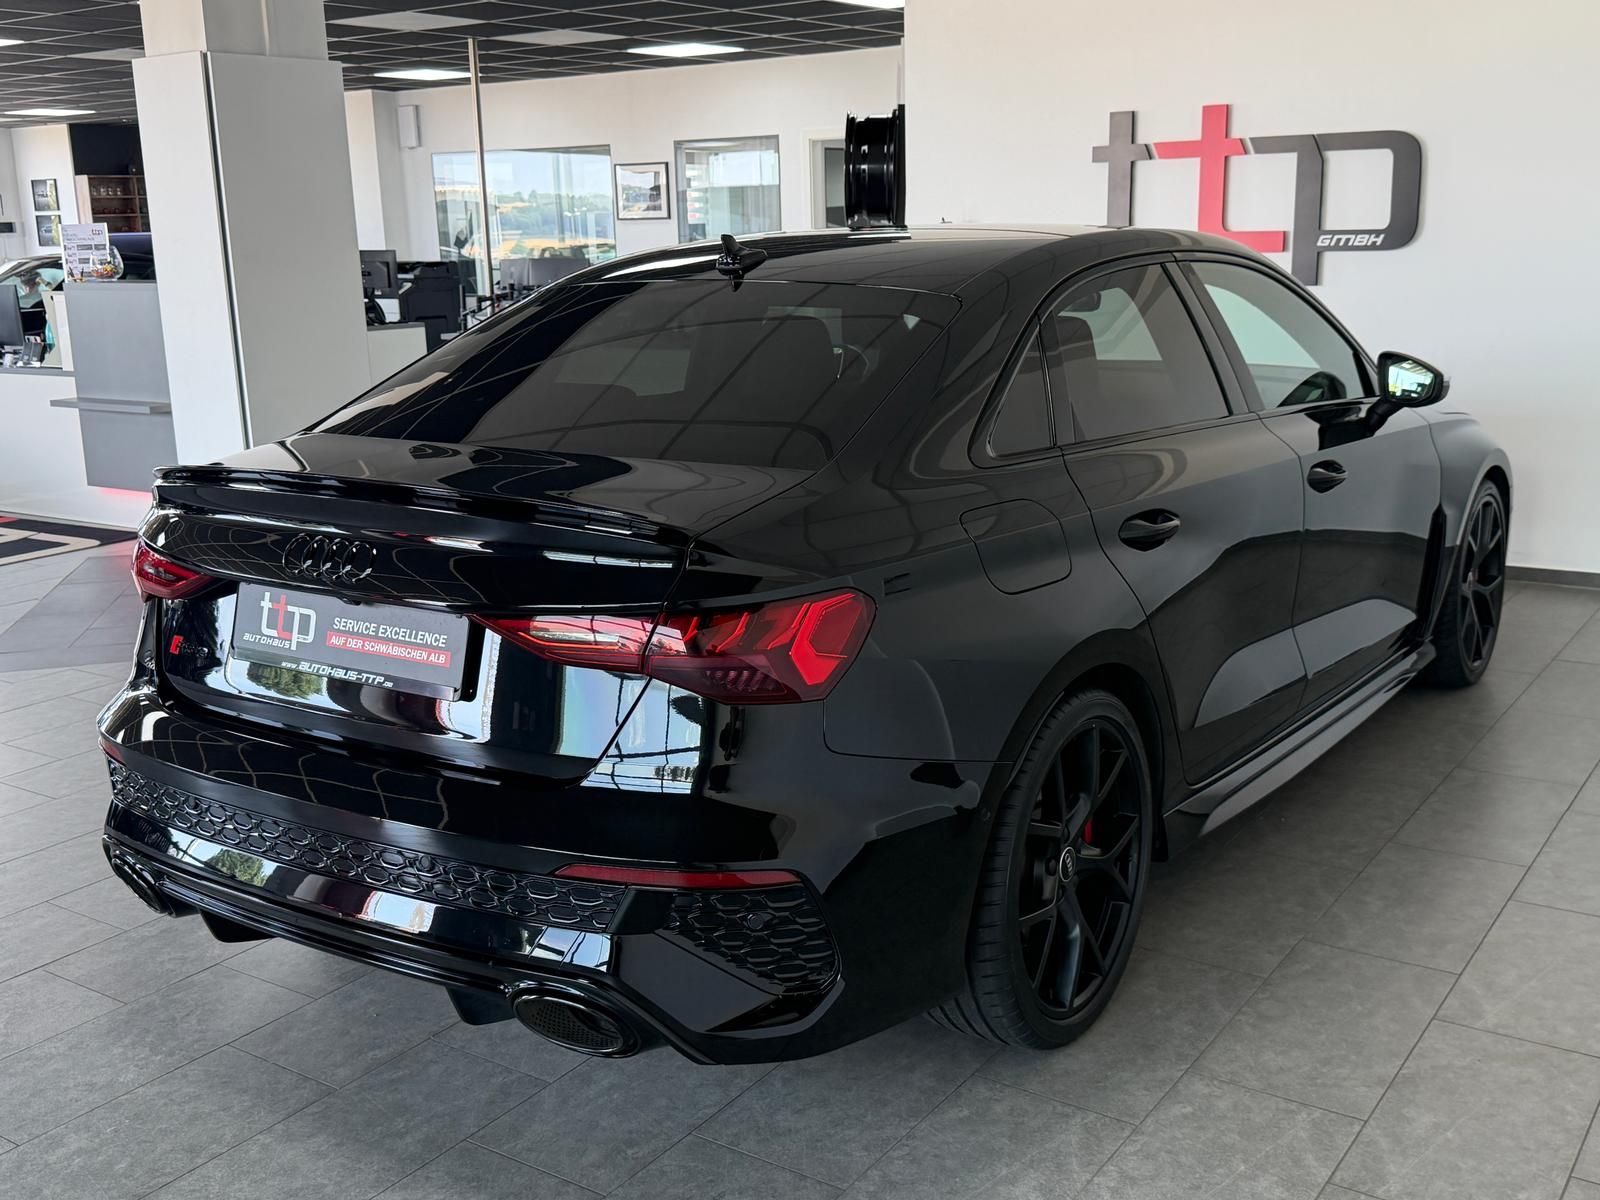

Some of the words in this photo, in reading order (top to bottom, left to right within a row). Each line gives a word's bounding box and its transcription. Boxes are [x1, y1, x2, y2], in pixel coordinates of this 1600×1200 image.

[1092, 104, 1422, 286] ttp
[260, 591, 317, 651] ttp
[333, 617, 377, 635] SERVICE
[378, 624, 447, 648] EXCELLENCE
[329, 635, 345, 646] AUF
[346, 639, 363, 649] DER
[363, 641, 429, 661] SCHWÄBISCHEN
[428, 652, 446, 664] ALB
